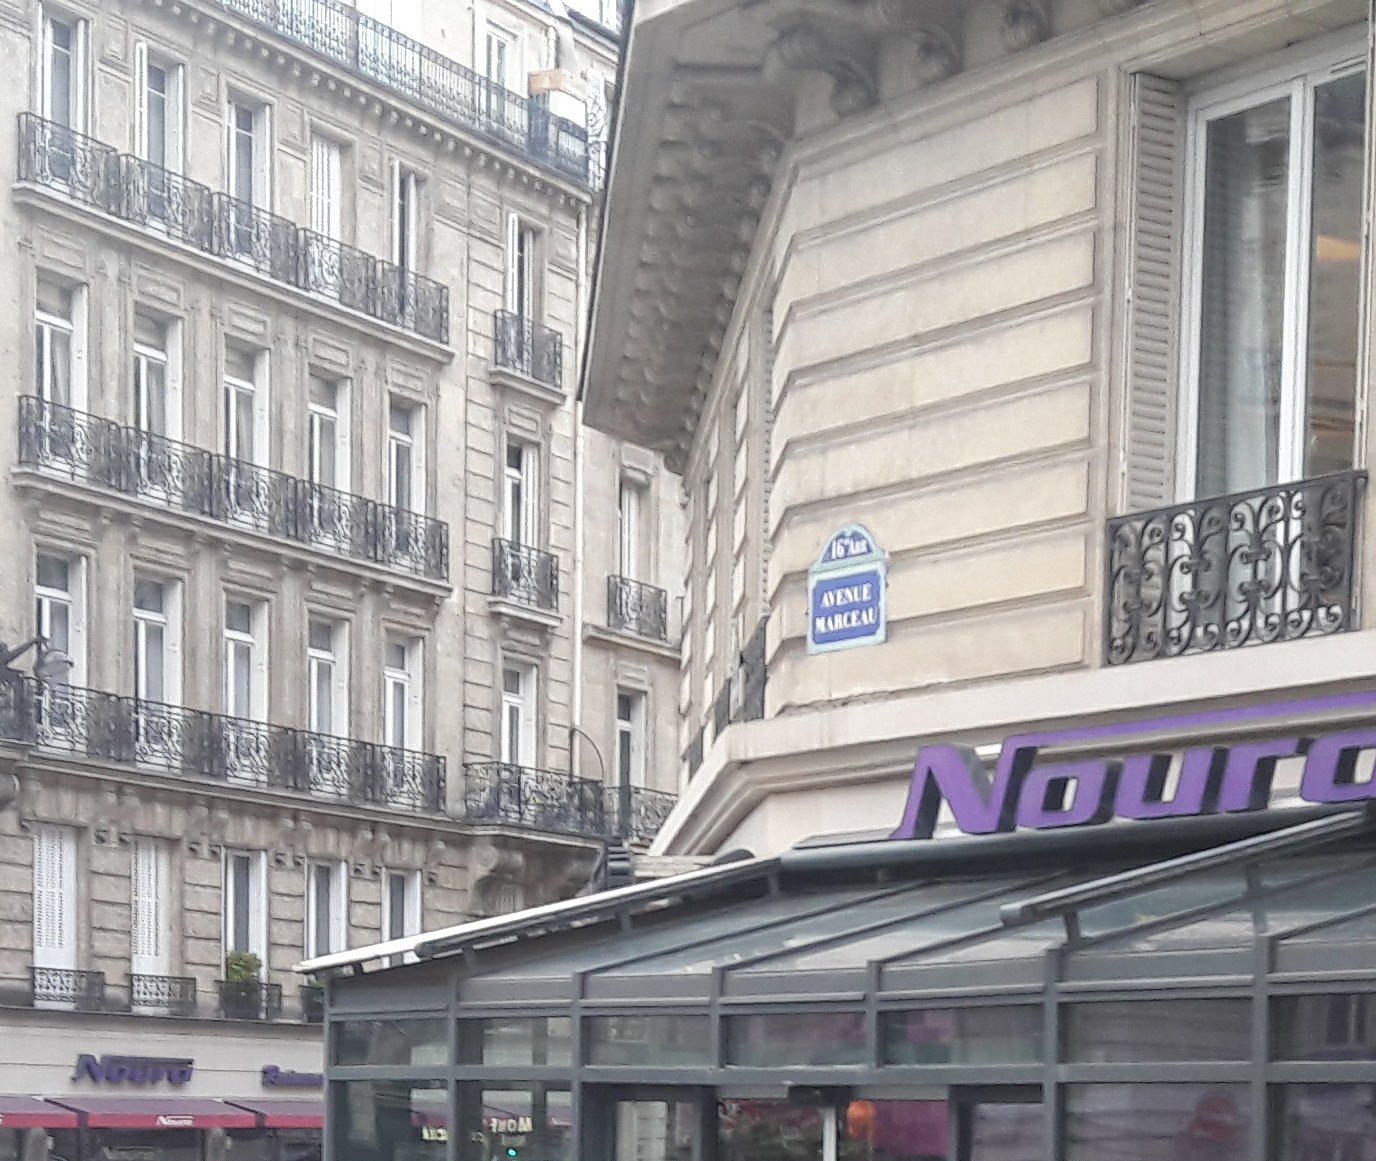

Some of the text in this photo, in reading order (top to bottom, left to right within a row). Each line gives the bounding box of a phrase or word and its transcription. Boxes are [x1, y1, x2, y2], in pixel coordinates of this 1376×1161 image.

[821, 581, 873, 608] AVENUE
[815, 606, 878, 635] MARCEAU
[70, 1053, 194, 1085] Noura
